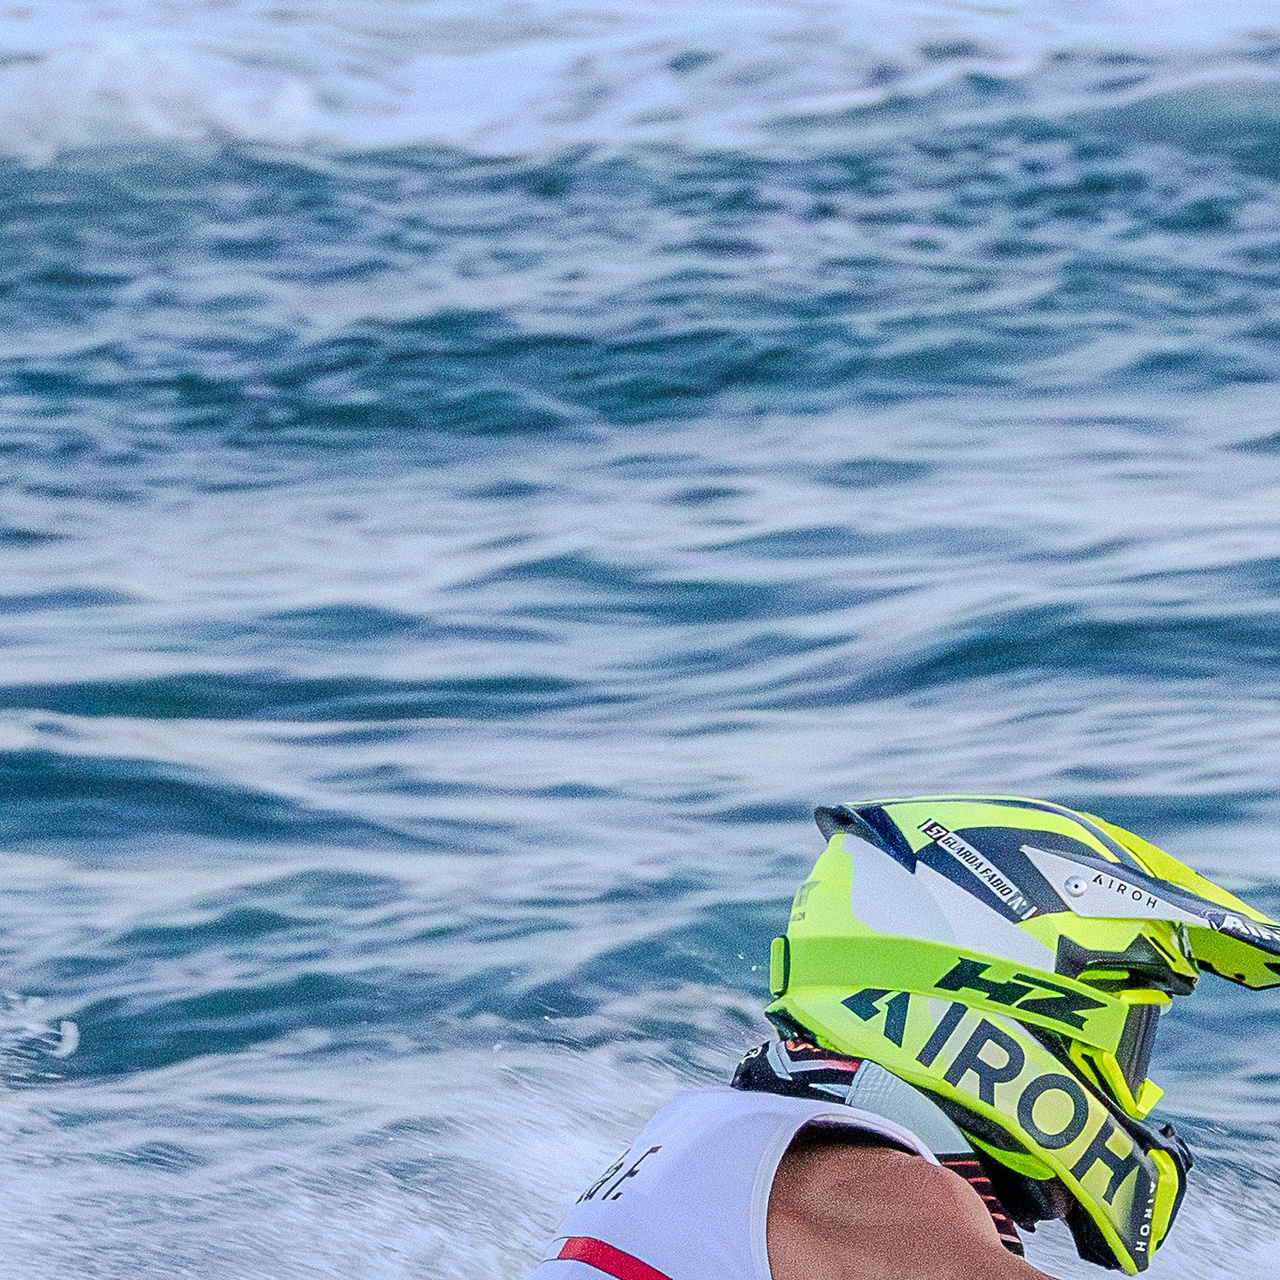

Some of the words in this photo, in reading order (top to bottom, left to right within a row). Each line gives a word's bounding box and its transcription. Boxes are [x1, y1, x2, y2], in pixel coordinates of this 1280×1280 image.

[942, 836, 984, 871] GUARDA
[1091, 873, 1158, 910] AIROH
[840, 988, 1140, 1206] AIROH
